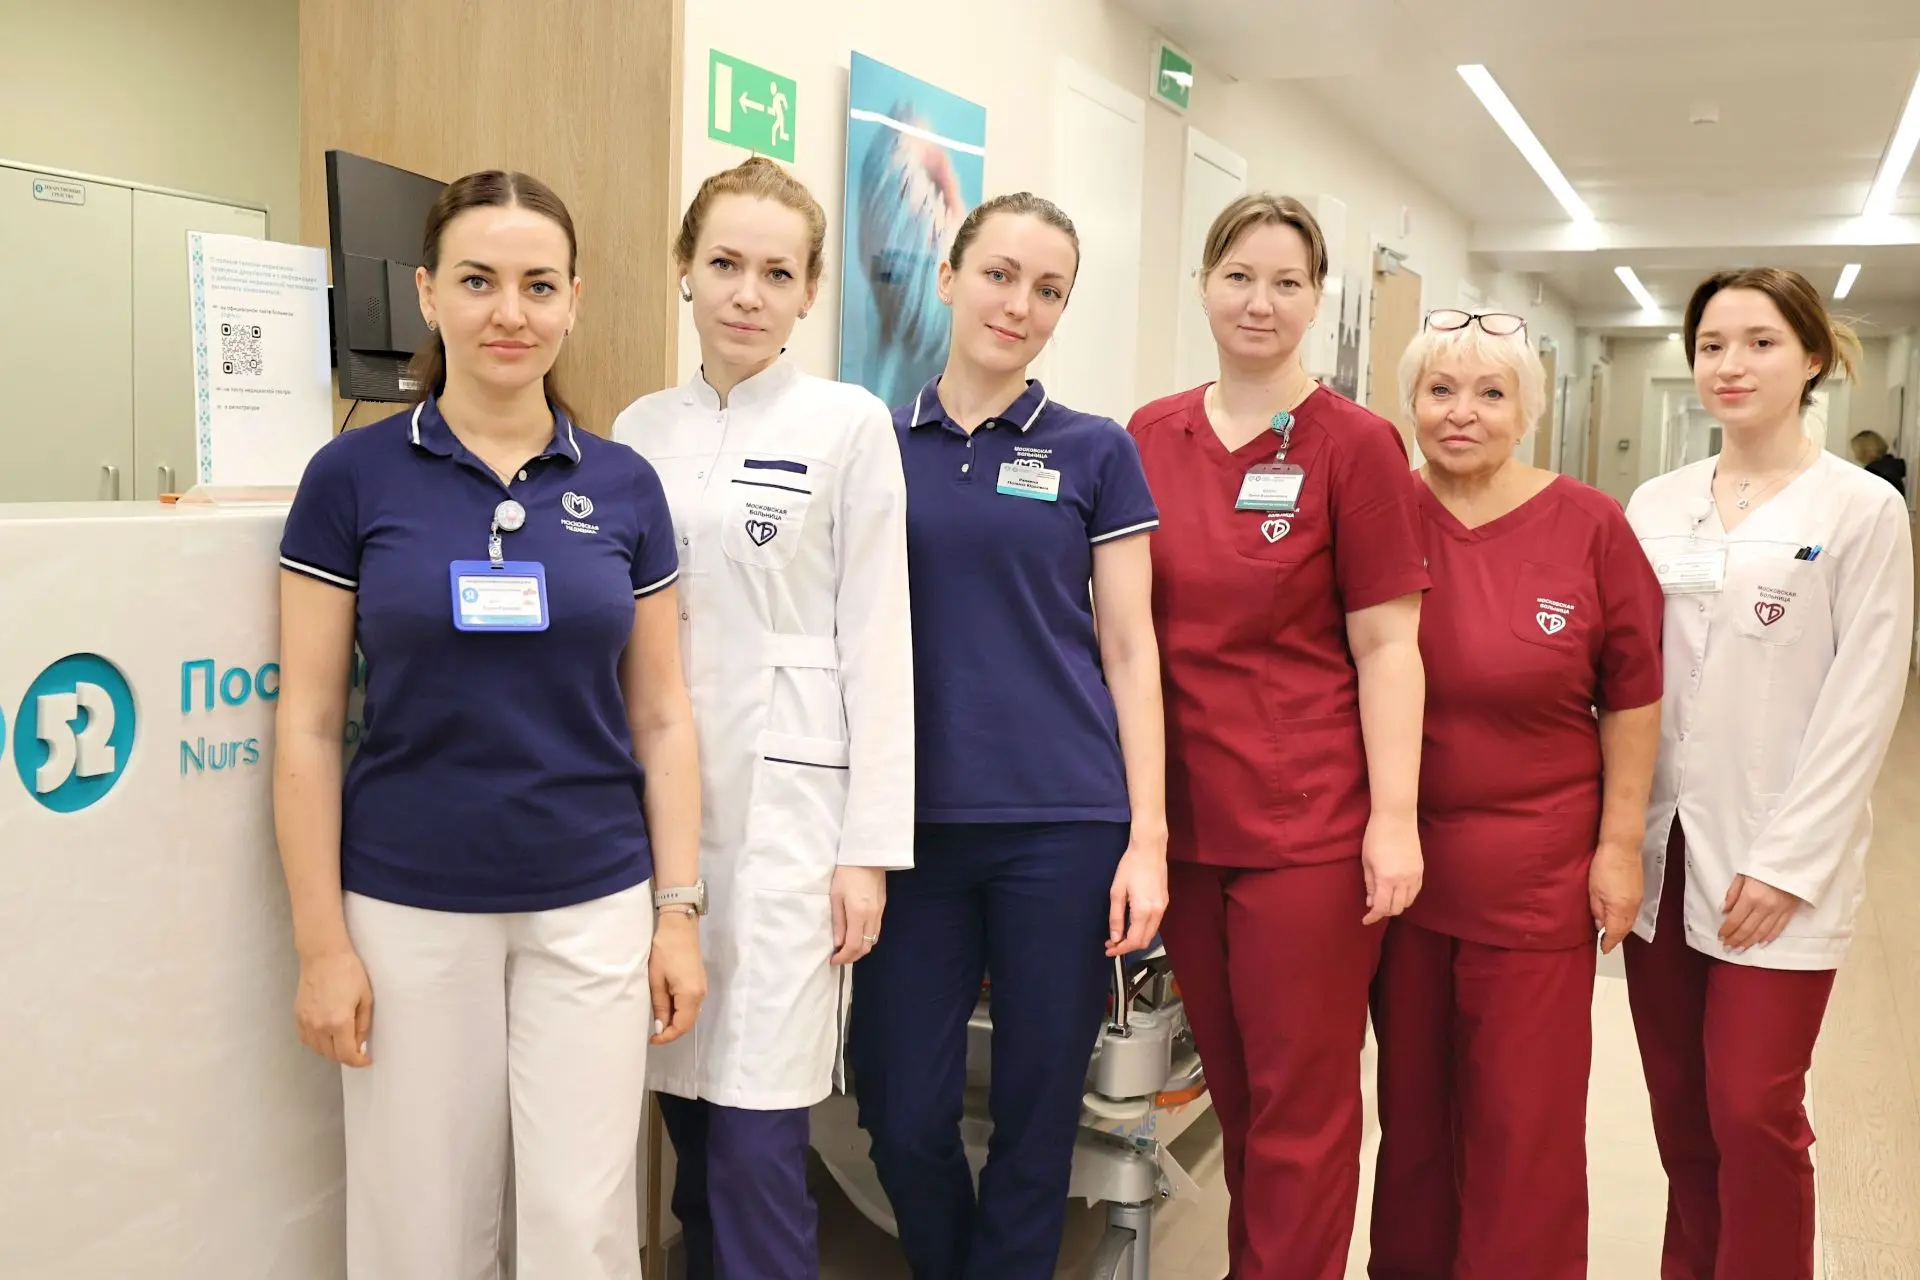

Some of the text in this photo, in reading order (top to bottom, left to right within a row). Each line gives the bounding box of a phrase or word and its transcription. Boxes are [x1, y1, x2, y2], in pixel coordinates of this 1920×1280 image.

[1014, 446, 1053, 455] МОСКОВСКАЯ
[746, 502, 788, 514] МОСКОВСКАЯ
[749, 509, 782, 521] БОЛЬНИЦА
[1757, 585, 1797, 597] МОСКОВСКАЯ
[1759, 592, 1791, 602] БОЛЬНИЦА
[1536, 598, 1575, 610] МОСКОВСКАЯ
[180, 658, 281, 714] Пос
[36, 681, 115, 794] 52
